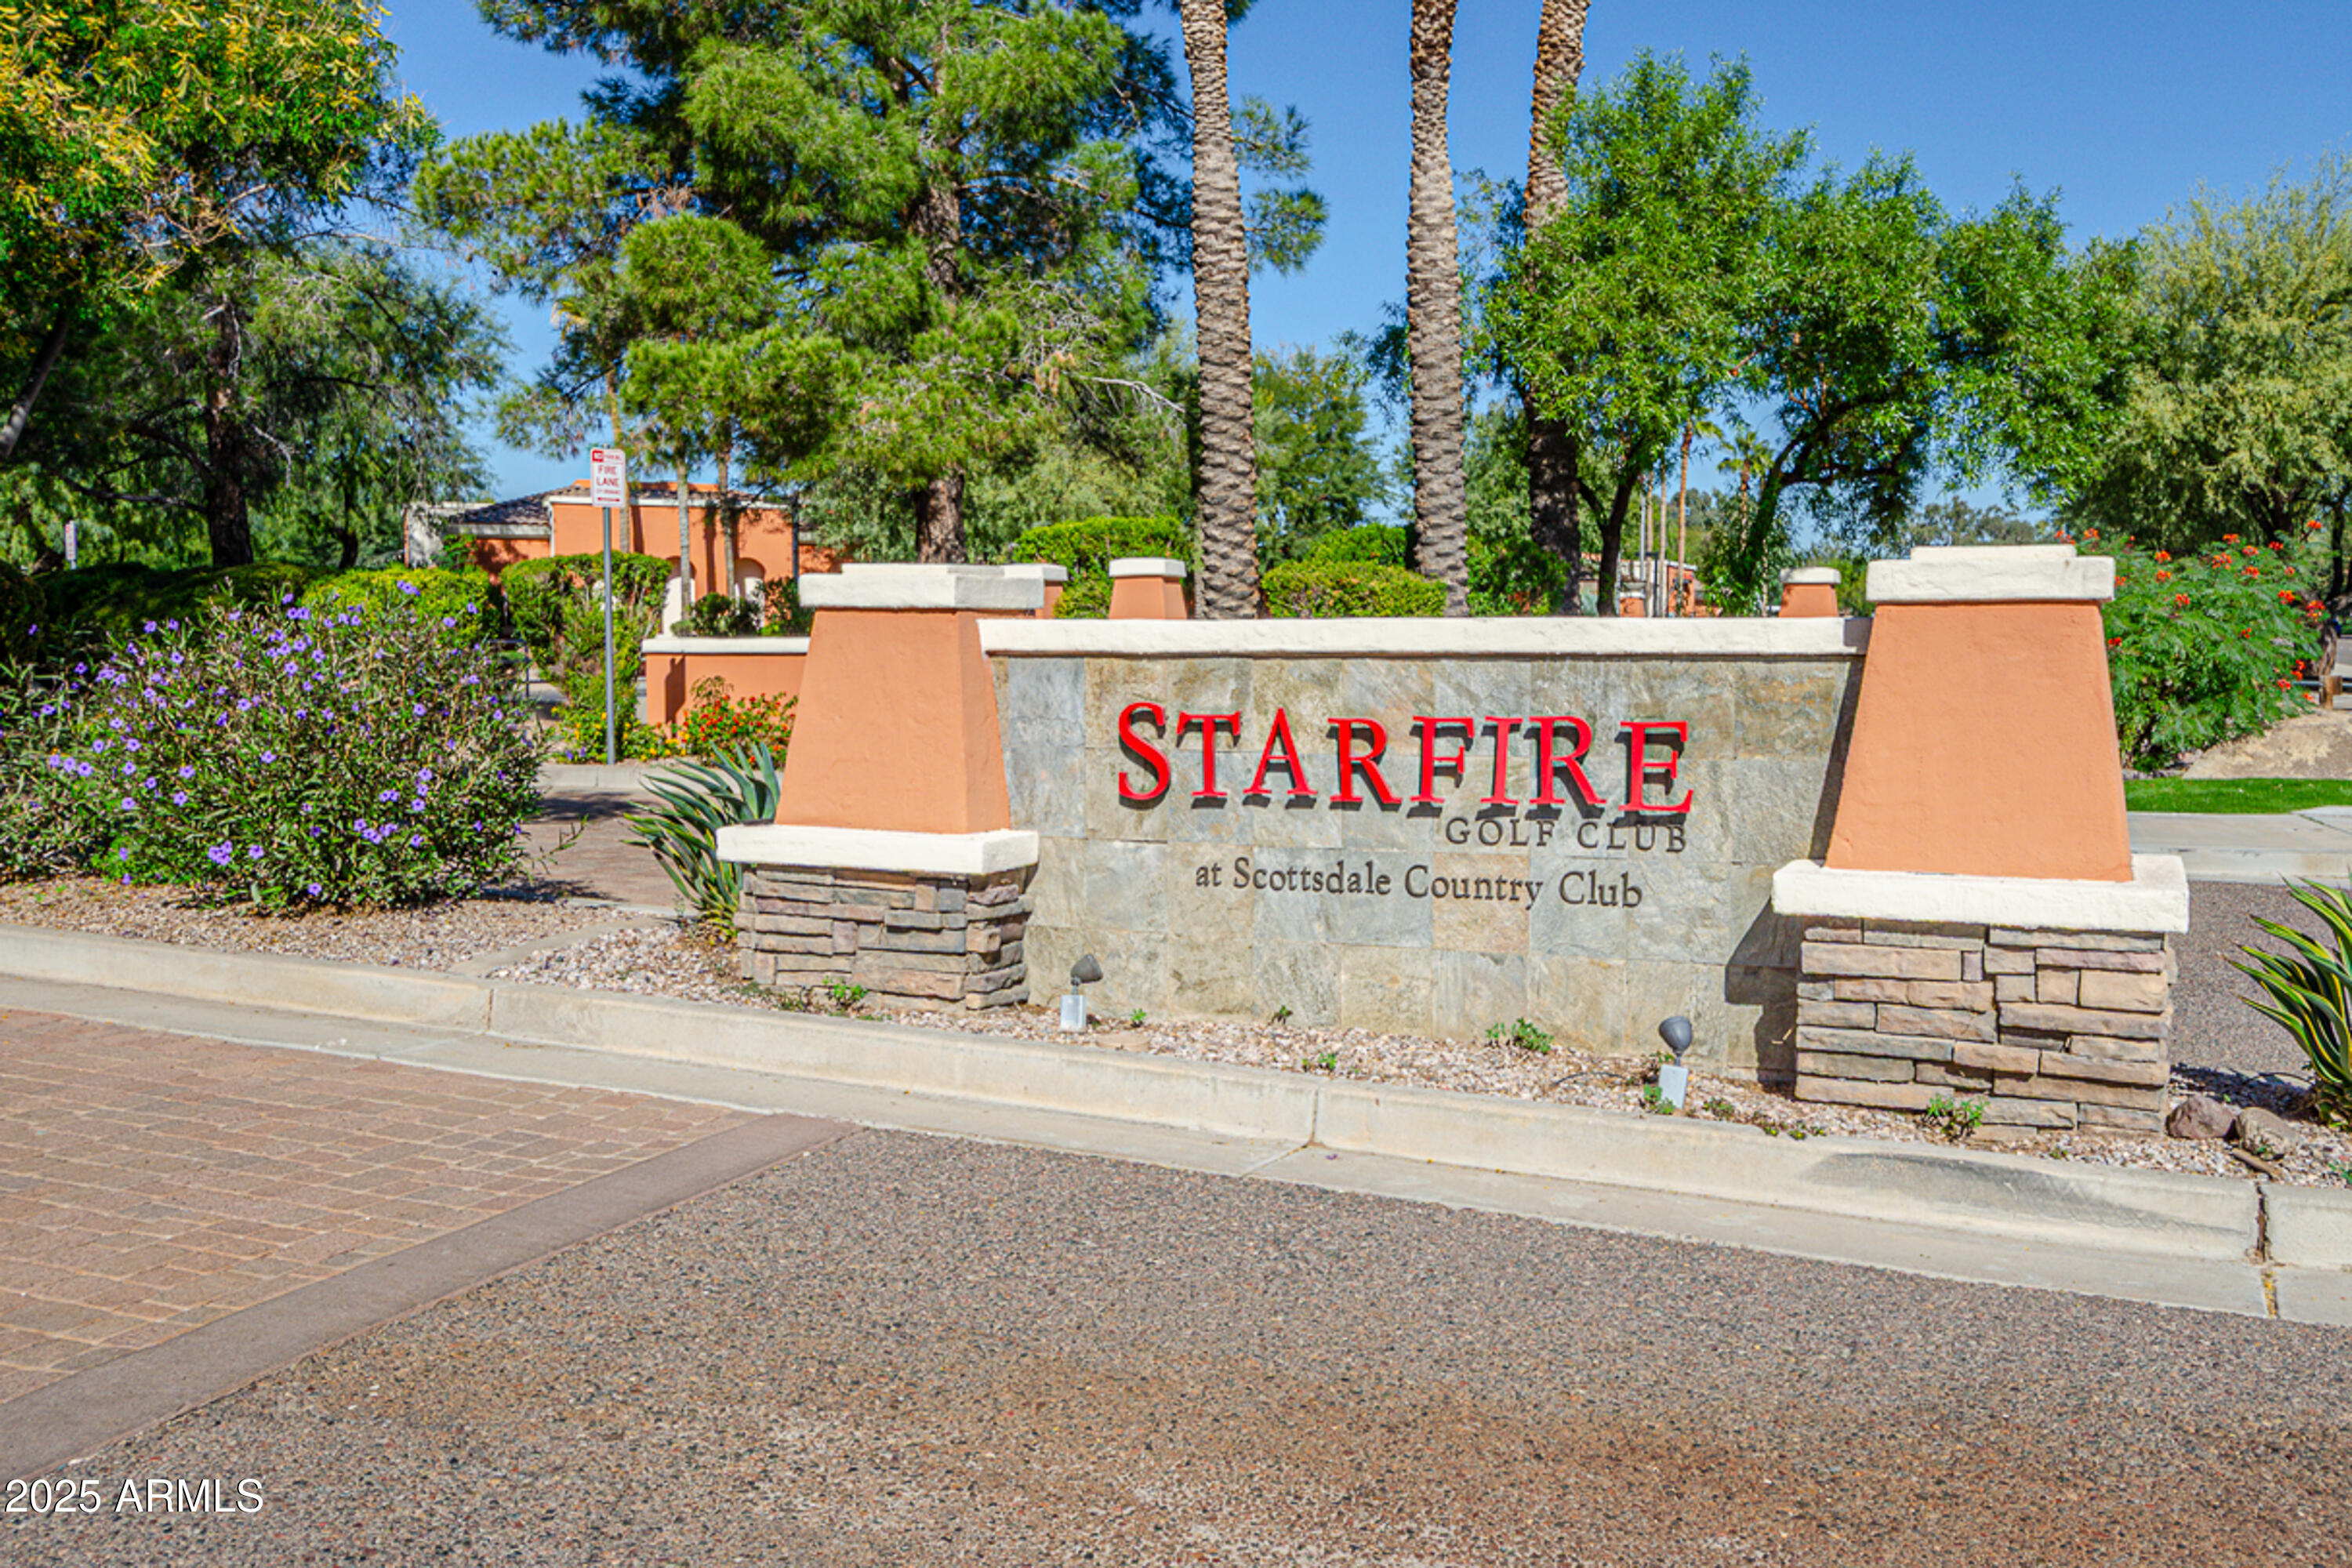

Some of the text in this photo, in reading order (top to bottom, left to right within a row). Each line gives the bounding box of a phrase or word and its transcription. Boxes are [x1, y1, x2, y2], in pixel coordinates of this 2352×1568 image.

[597, 477, 619, 488] LANE
[598, 465, 617, 475] FIRE
[1117, 701, 1694, 814] STARFIRE
[1445, 817, 1687, 852] GOLF CLUB
[1195, 857, 1643, 910] at Scottsdale Country Club
